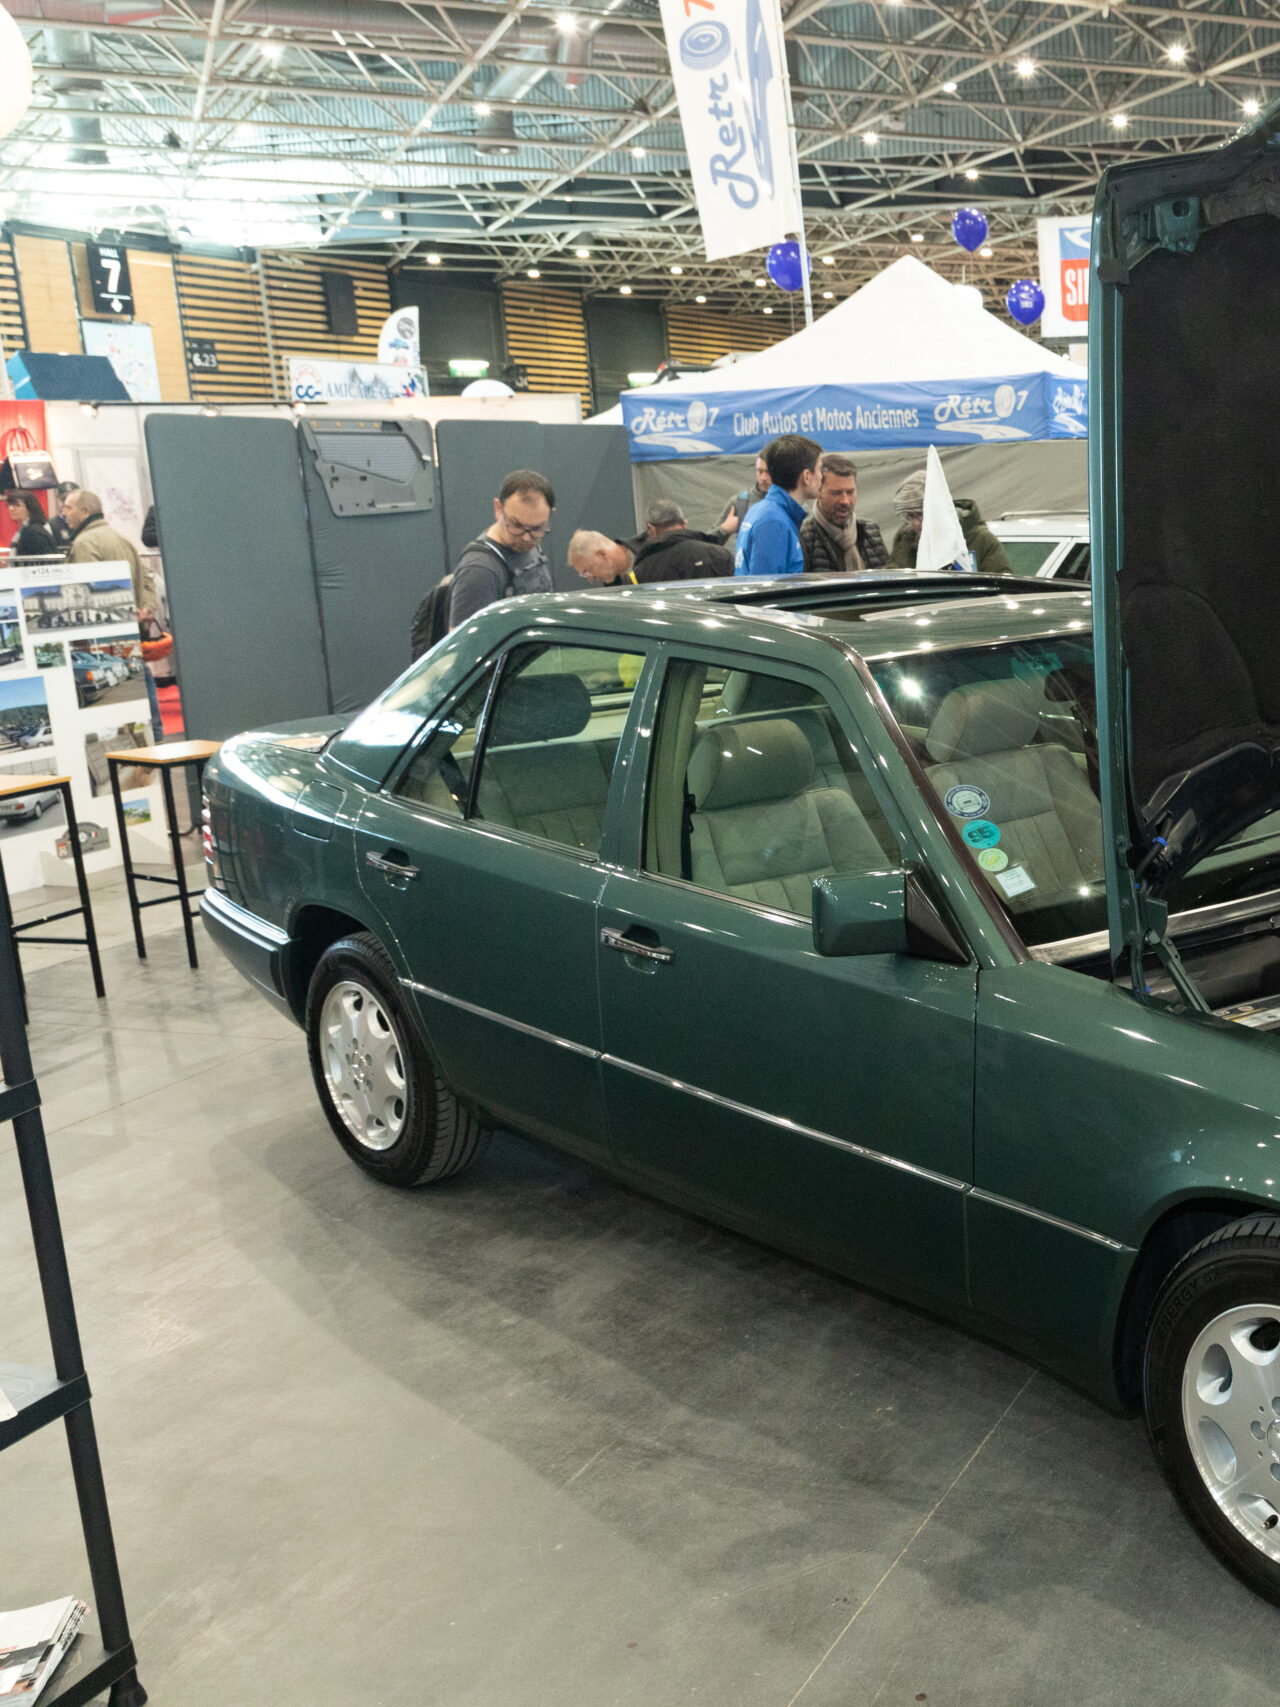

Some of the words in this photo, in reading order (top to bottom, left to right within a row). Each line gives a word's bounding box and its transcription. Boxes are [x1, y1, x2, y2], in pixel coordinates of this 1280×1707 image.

[101, 259, 121, 293] 7
[1064, 267, 1090, 306] SI
[193, 353, 218, 368] 6.23
[1017, 390, 1029, 411] 7
[733, 411, 759, 437] Club
[762, 410, 798, 435] Autos
[800, 409, 816, 432] et
[816, 405, 853, 431] Motos
[855, 404, 920, 430] Anciennes
